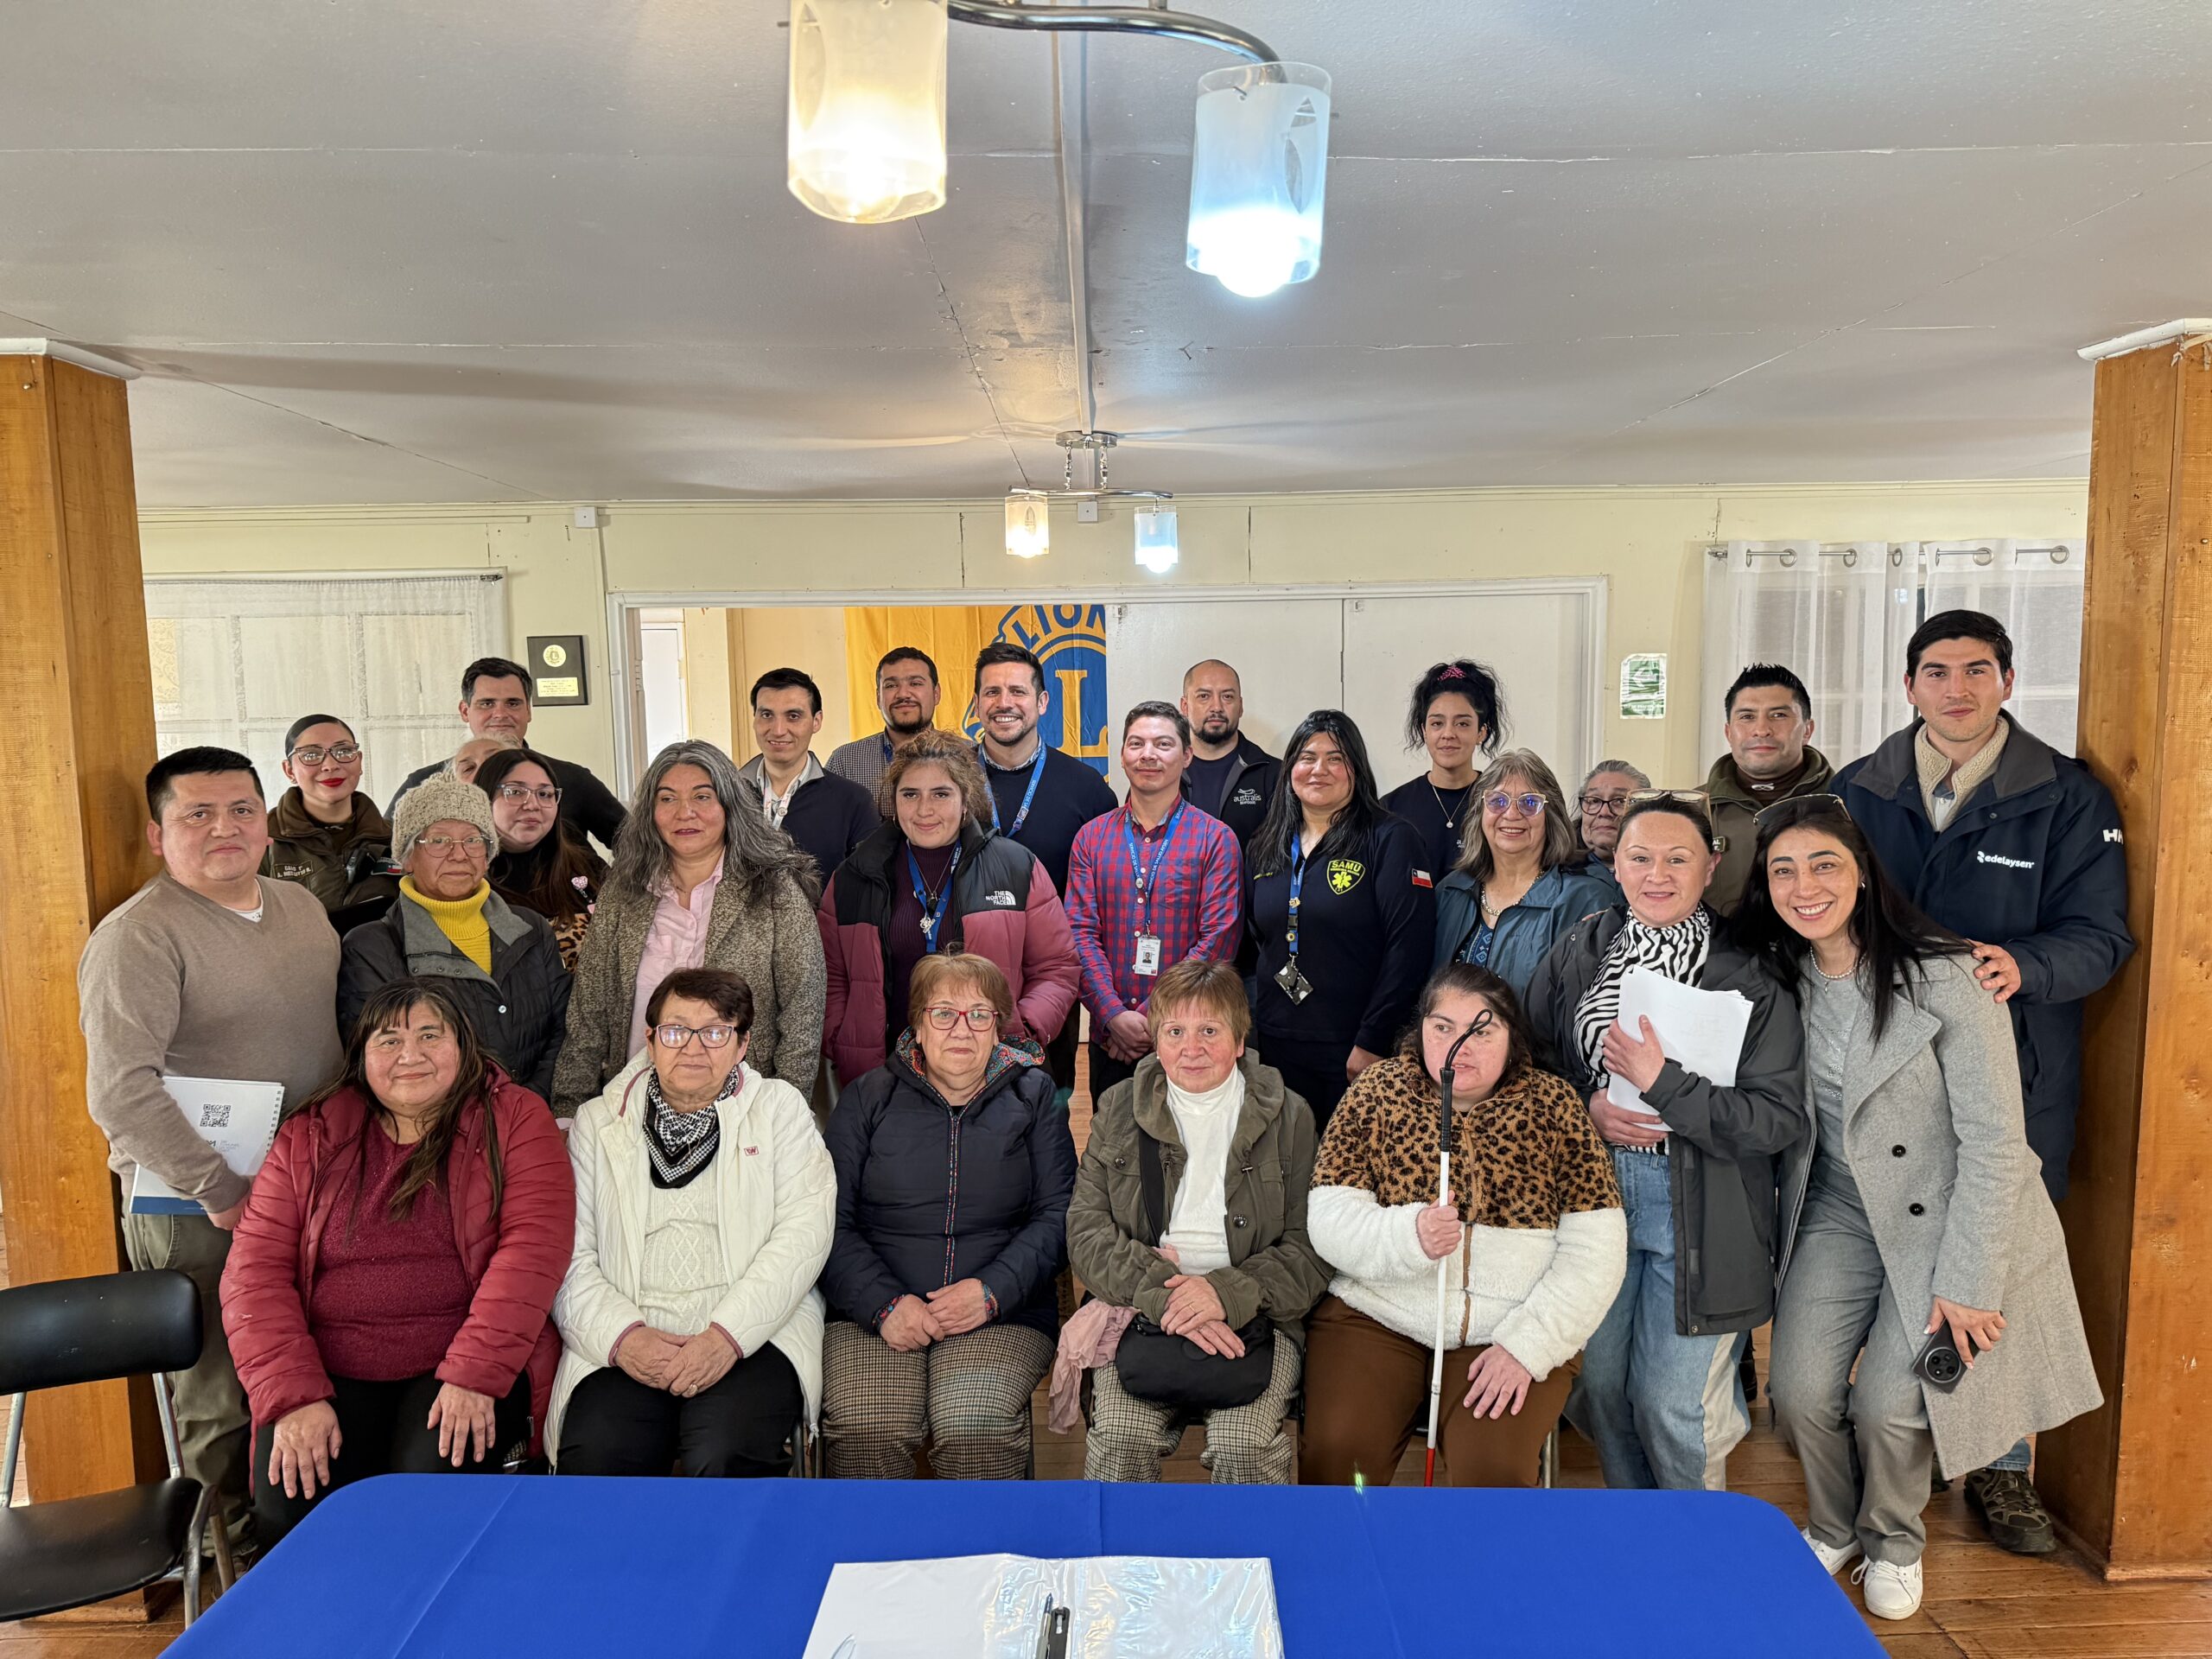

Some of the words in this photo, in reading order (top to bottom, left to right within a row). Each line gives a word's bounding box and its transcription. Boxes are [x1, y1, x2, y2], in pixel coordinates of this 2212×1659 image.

[1055, 670, 1109, 758] L
[1234, 793, 1262, 802] australis
[1332, 861, 1362, 873] SAMU
[1984, 854, 2034, 868] edelaysen
